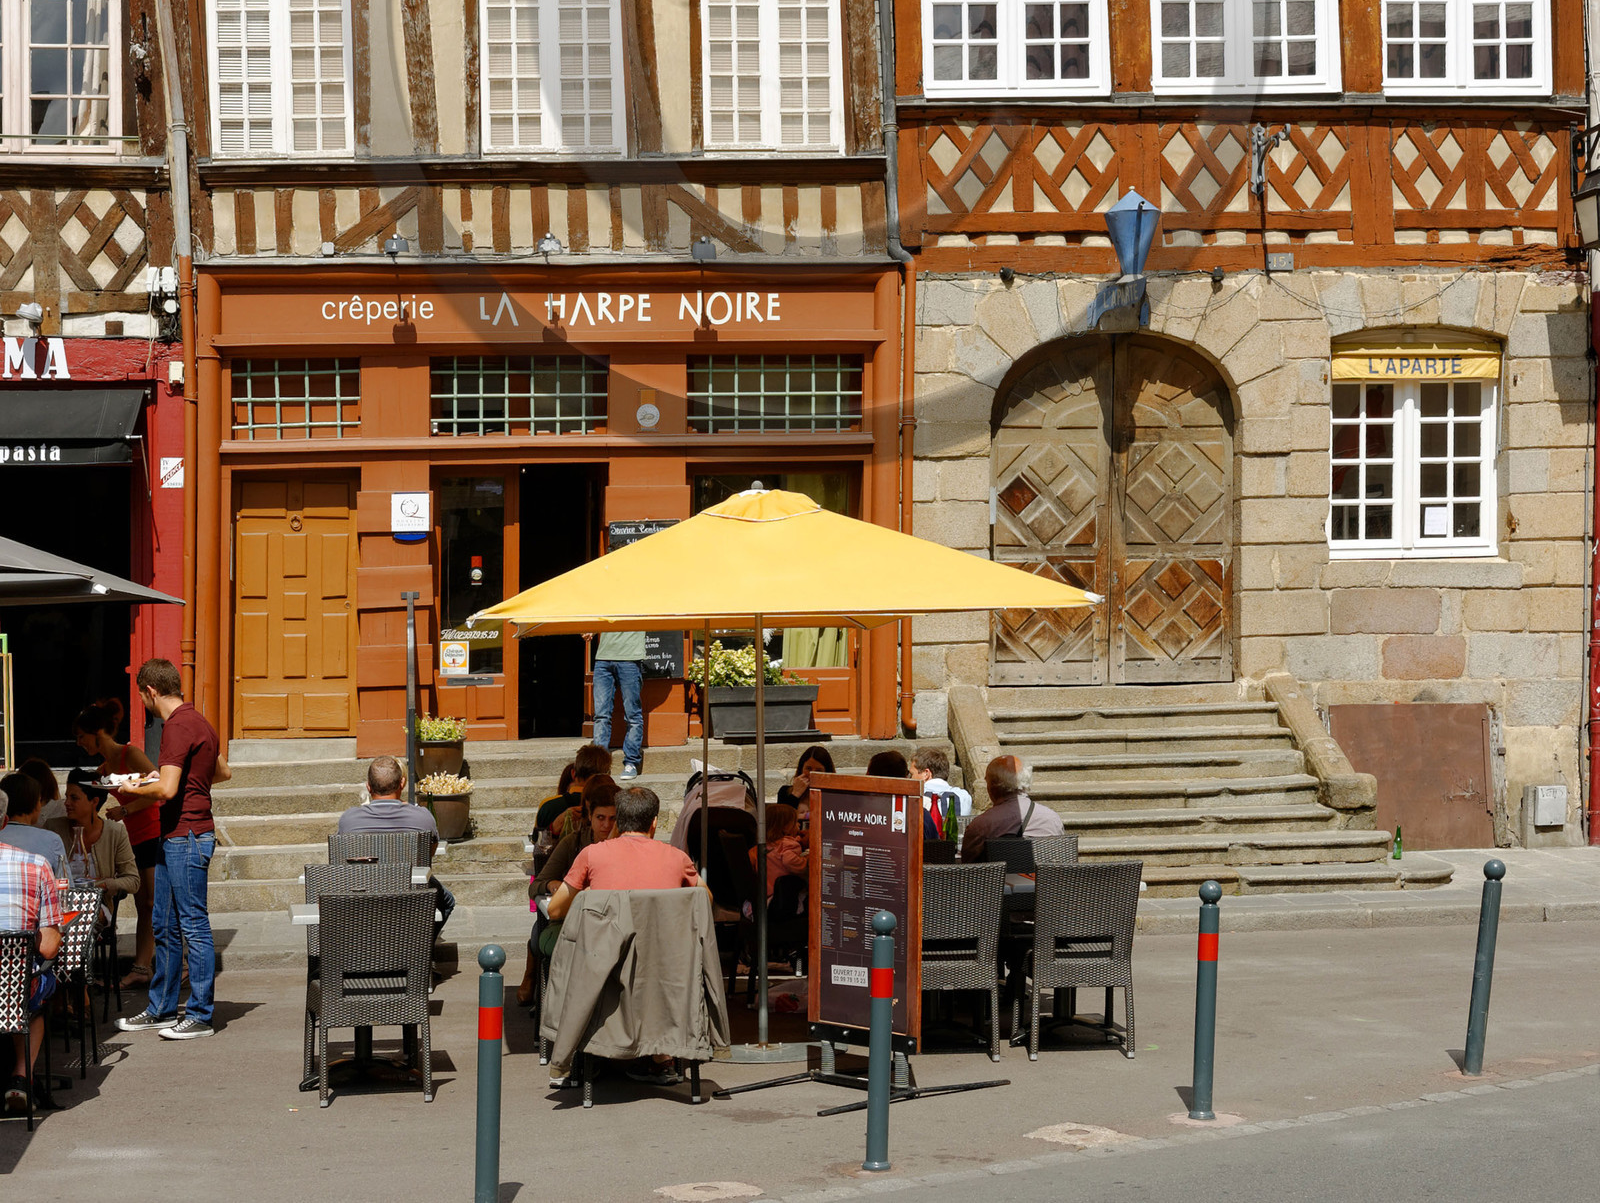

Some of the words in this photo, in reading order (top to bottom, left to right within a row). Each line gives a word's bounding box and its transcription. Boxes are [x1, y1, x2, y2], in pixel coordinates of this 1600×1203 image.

[1272, 256, 1287, 268] 15
[321, 294, 434, 325] crêperie
[479, 291, 519, 327] LA
[544, 291, 652, 326] HARPE
[678, 289, 781, 326] NOIRE
[2, 337, 71, 379] MA
[1368, 354, 1463, 374] L'APARTÉ
[0, 443, 61, 464] pasta
[610, 524, 635, 535] Service
[825, 810, 835, 821] LA
[838, 811, 861, 822] HARPE
[864, 813, 887, 825] NOIRE
[833, 968, 853, 976] OUVERT
